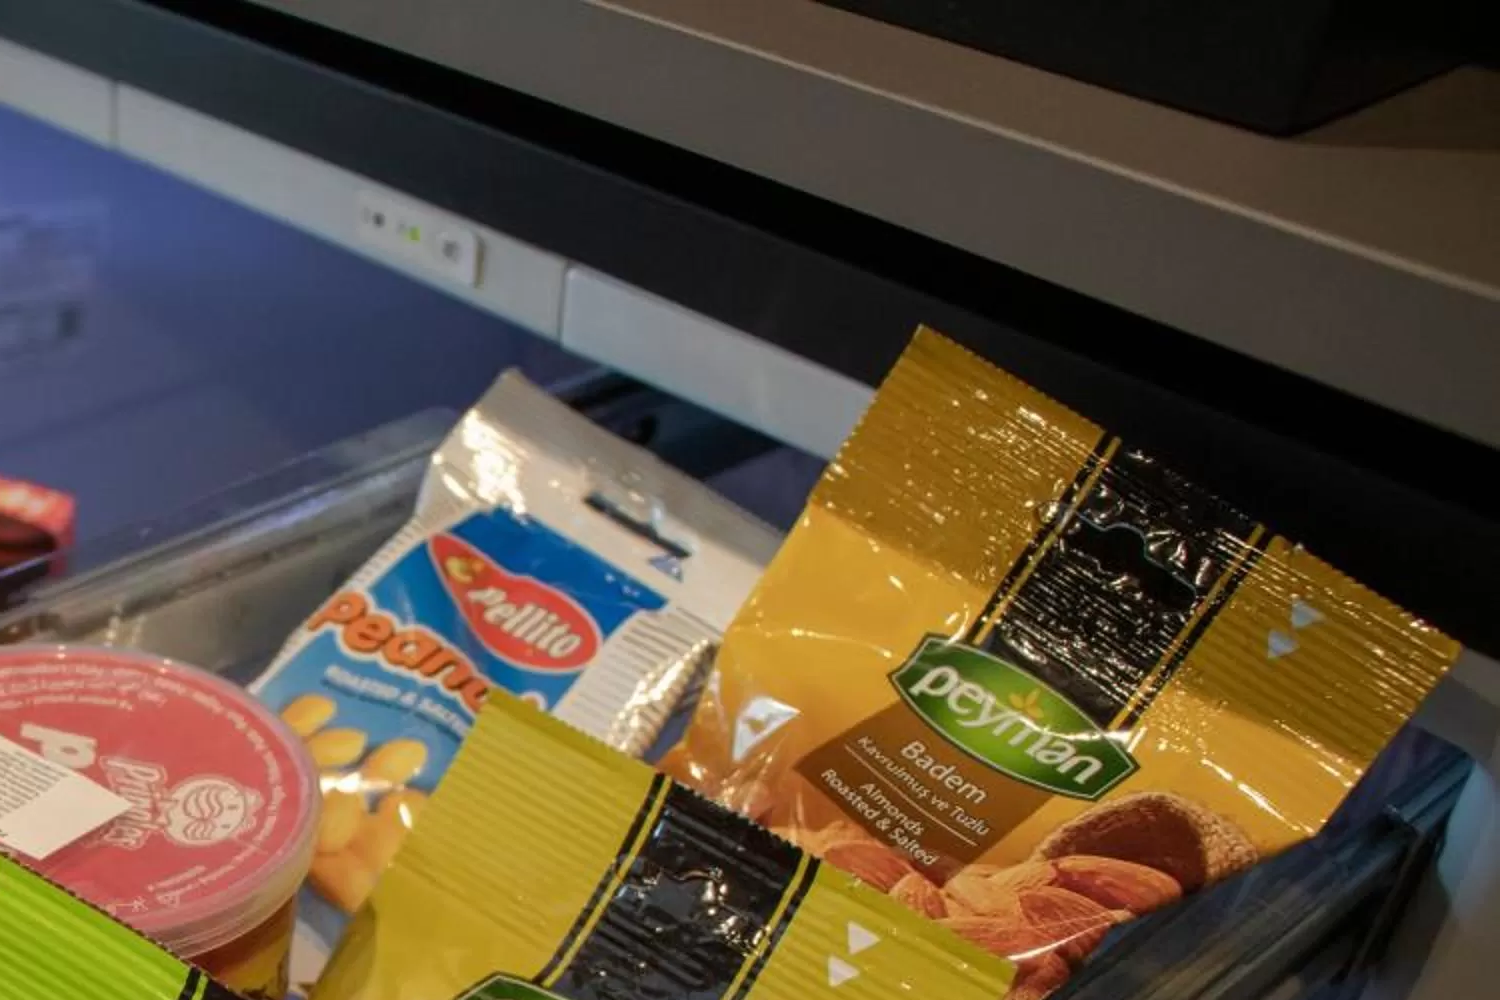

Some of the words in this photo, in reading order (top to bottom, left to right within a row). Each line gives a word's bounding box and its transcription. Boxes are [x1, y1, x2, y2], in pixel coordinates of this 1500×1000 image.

[467, 586, 582, 659] Pellito
[909, 664, 1104, 785] peyman
[857, 735, 930, 799] Kavrulmuş
[931, 794, 949, 811] ve
[949, 805, 990, 836] Tuzlu
[860, 783, 925, 836] Almonds
[900, 740, 987, 804] Badem
[821, 768, 881, 820] Roasted
[875, 818, 891, 832] &
[888, 827, 941, 866] Salted
